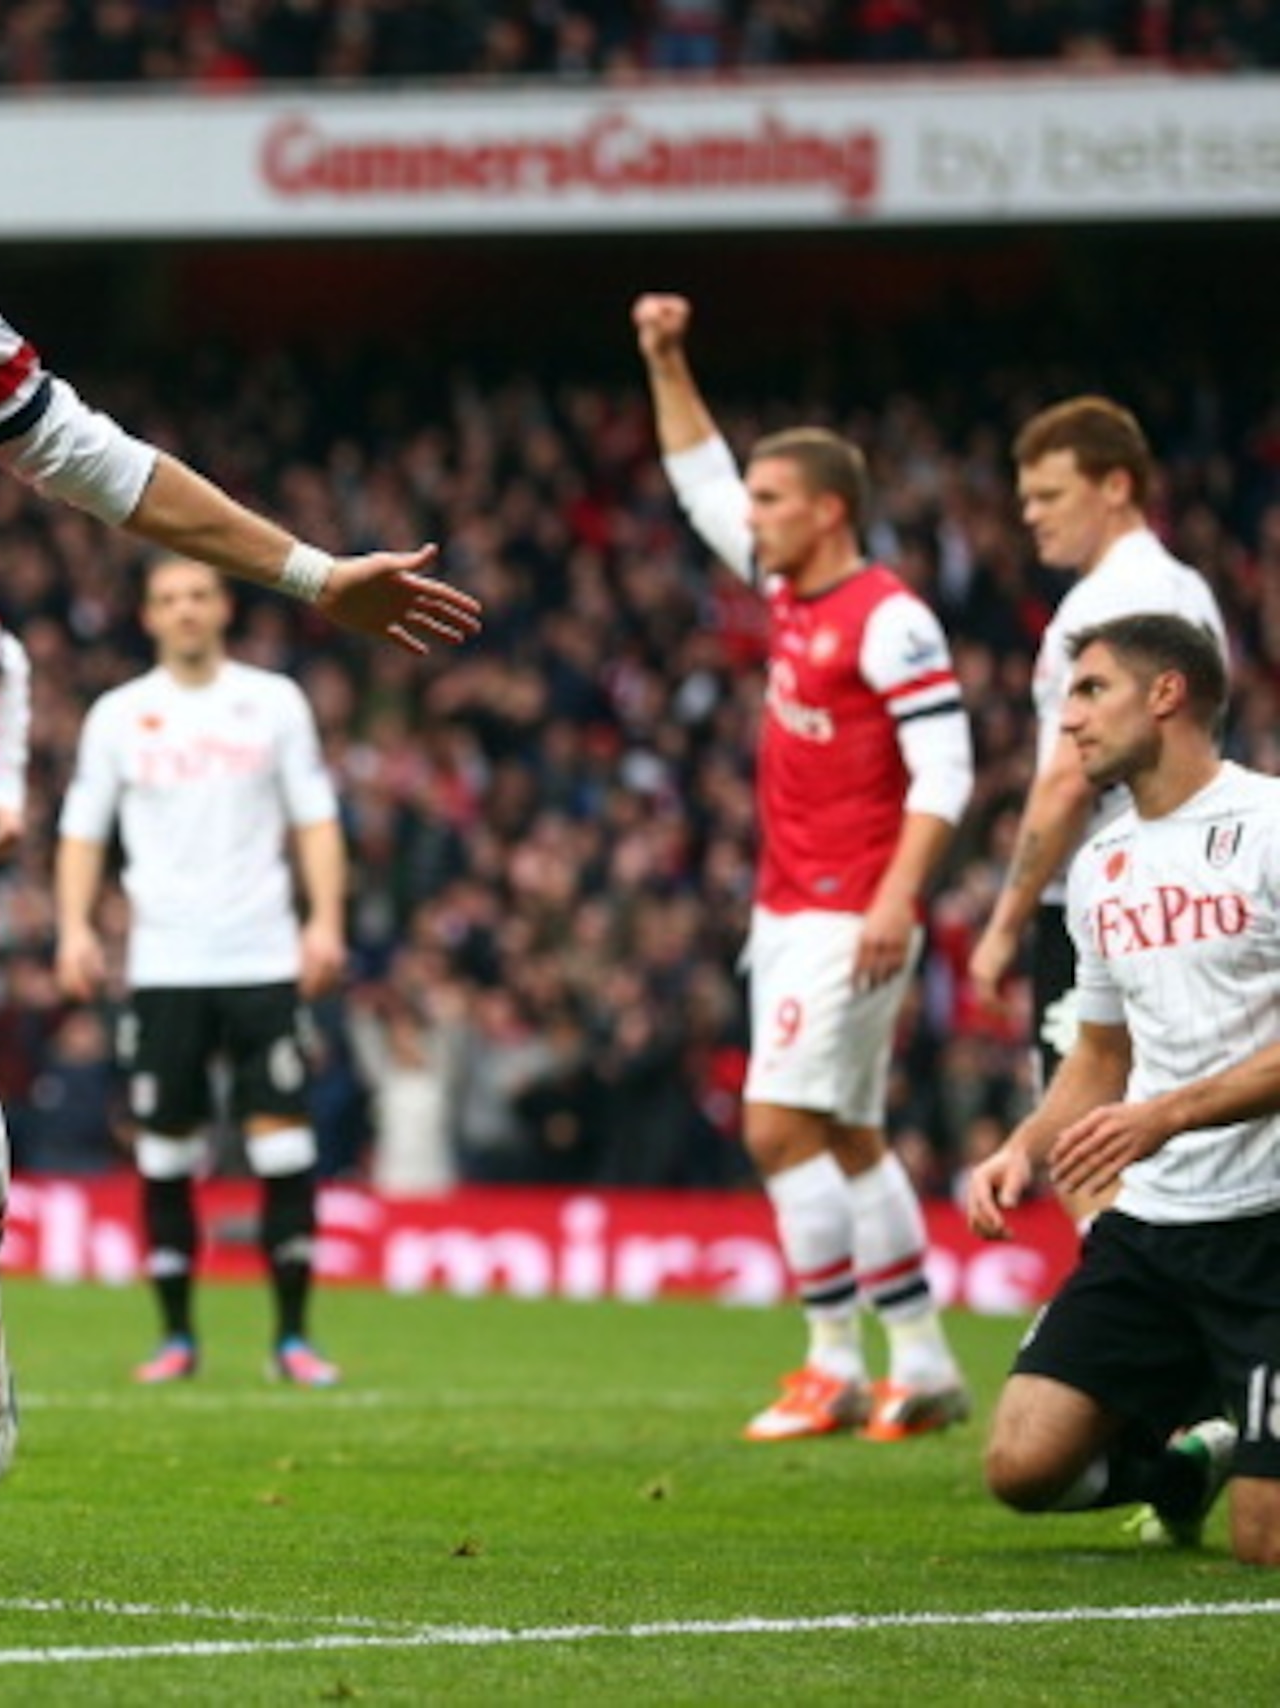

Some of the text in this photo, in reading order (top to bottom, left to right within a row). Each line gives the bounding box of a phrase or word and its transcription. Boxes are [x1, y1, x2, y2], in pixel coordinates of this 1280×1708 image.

[256, 110, 882, 218] GunnersGaming
[1093, 883, 1250, 960] FxPro
[775, 997, 803, 1048] 9
